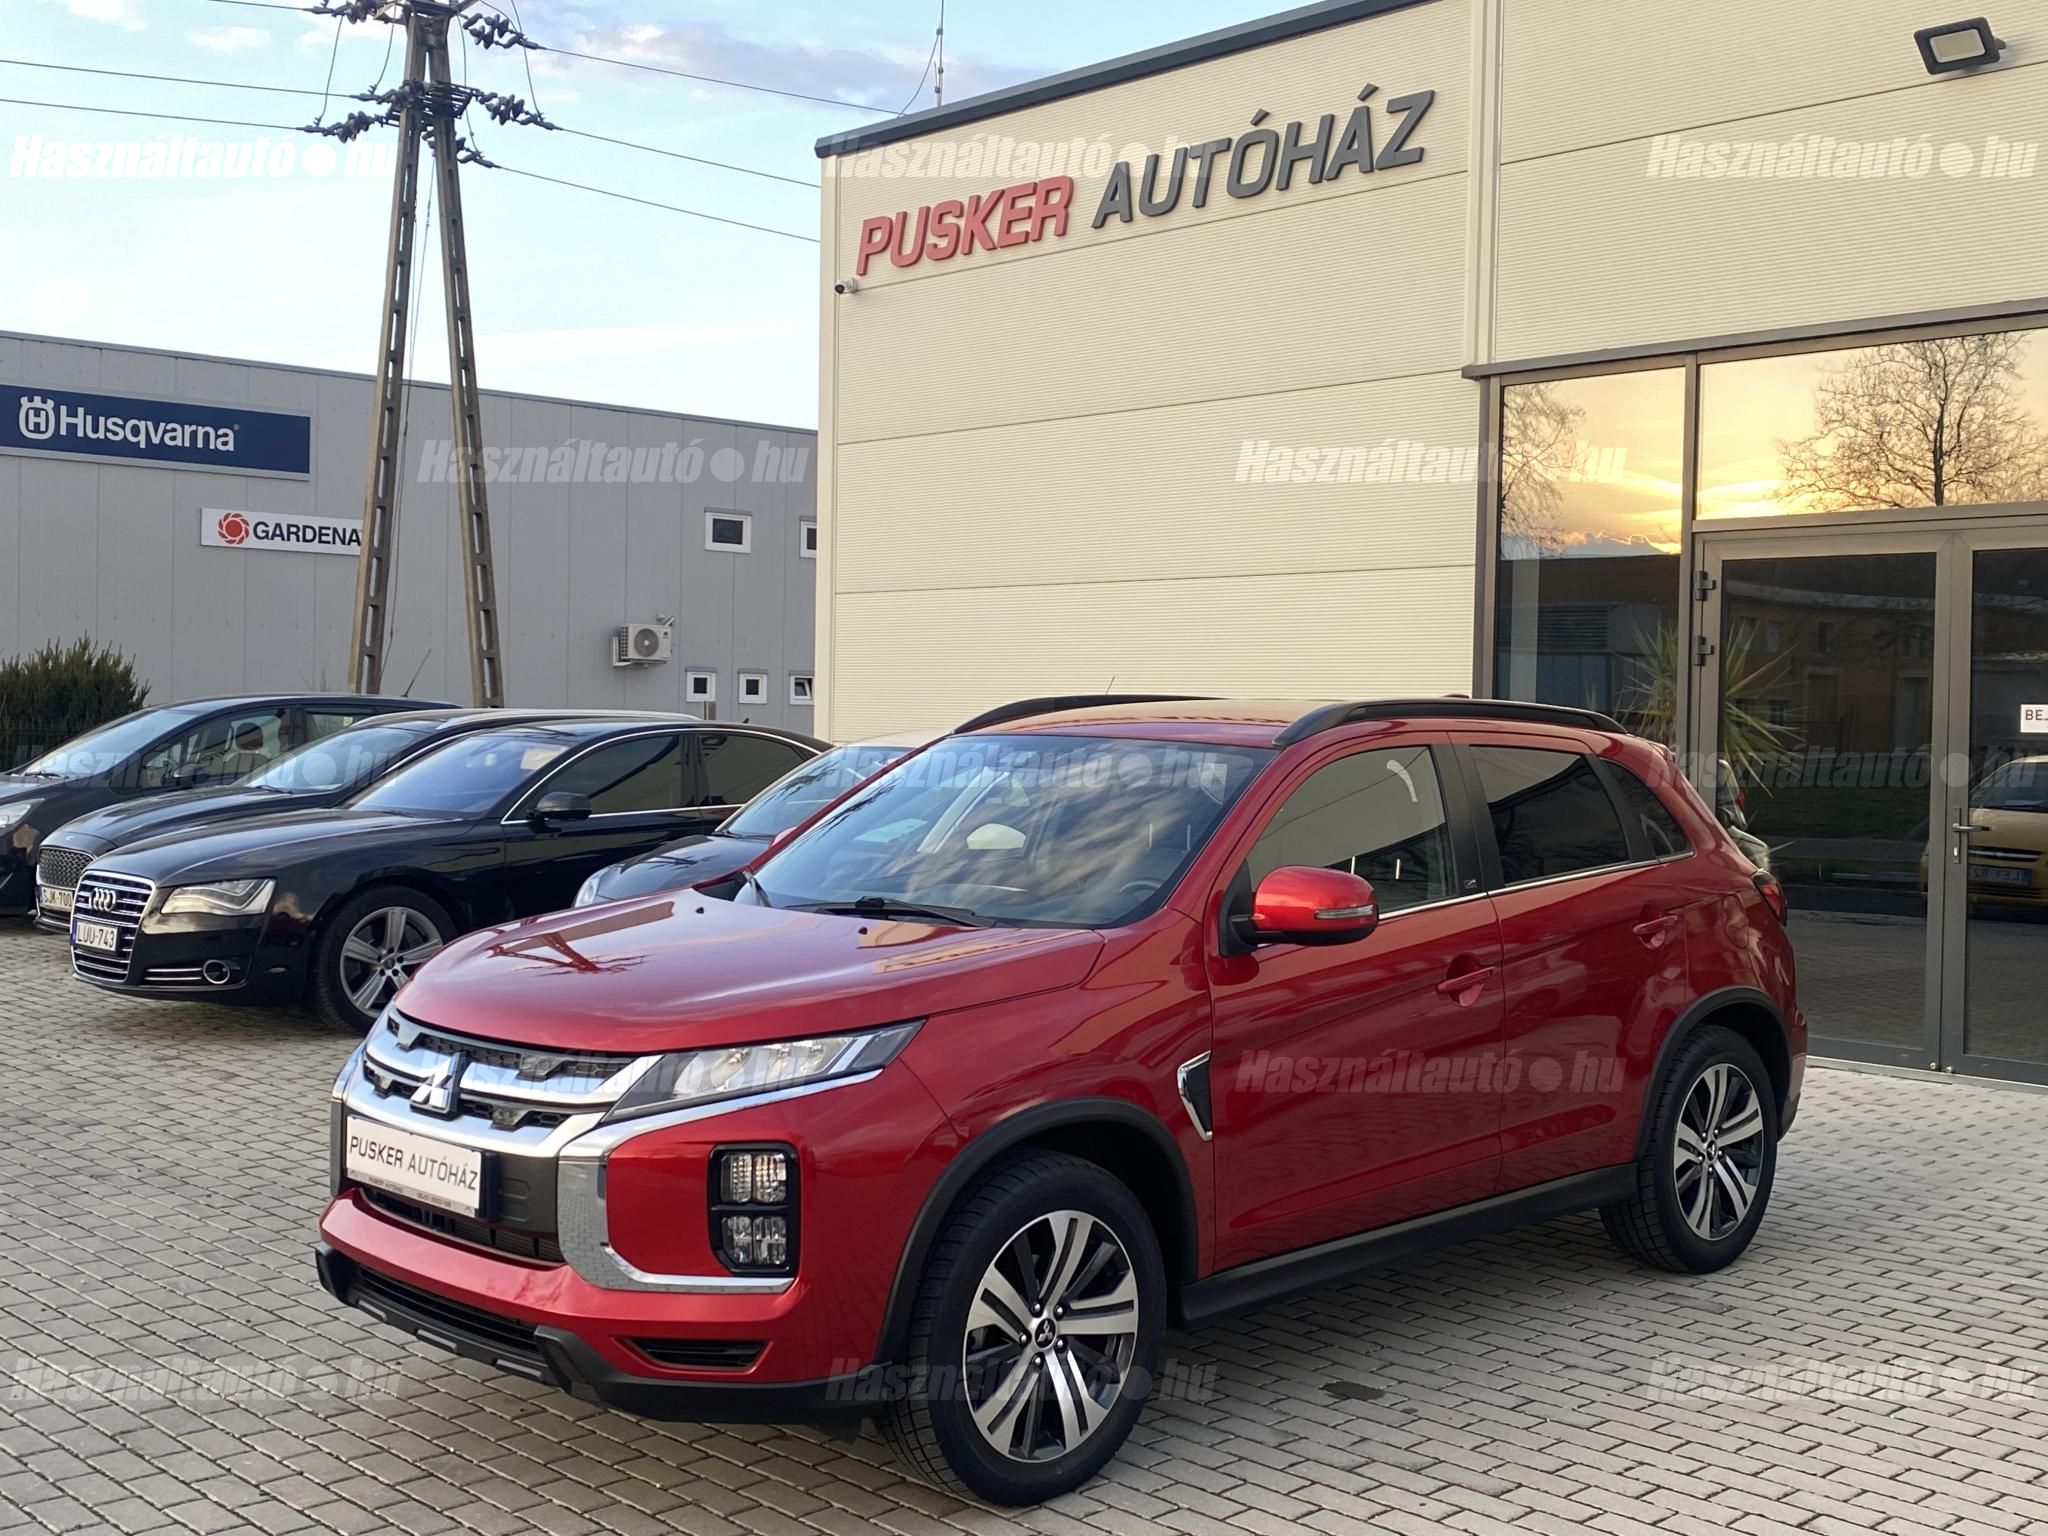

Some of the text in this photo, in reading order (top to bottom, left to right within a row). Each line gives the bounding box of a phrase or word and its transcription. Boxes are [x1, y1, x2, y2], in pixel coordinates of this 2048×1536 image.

[856, 82, 1435, 277] PUSKER AUTÓHÁZ
[60, 405, 235, 451] Husqvarna
[253, 521, 361, 547] GARDENA
[2025, 709, 2048, 721] BE
[77, 923, 115, 948] LUU-743
[349, 1135, 404, 1169] PUSKER
[407, 1153, 478, 1191] AUTÓHÁZ
